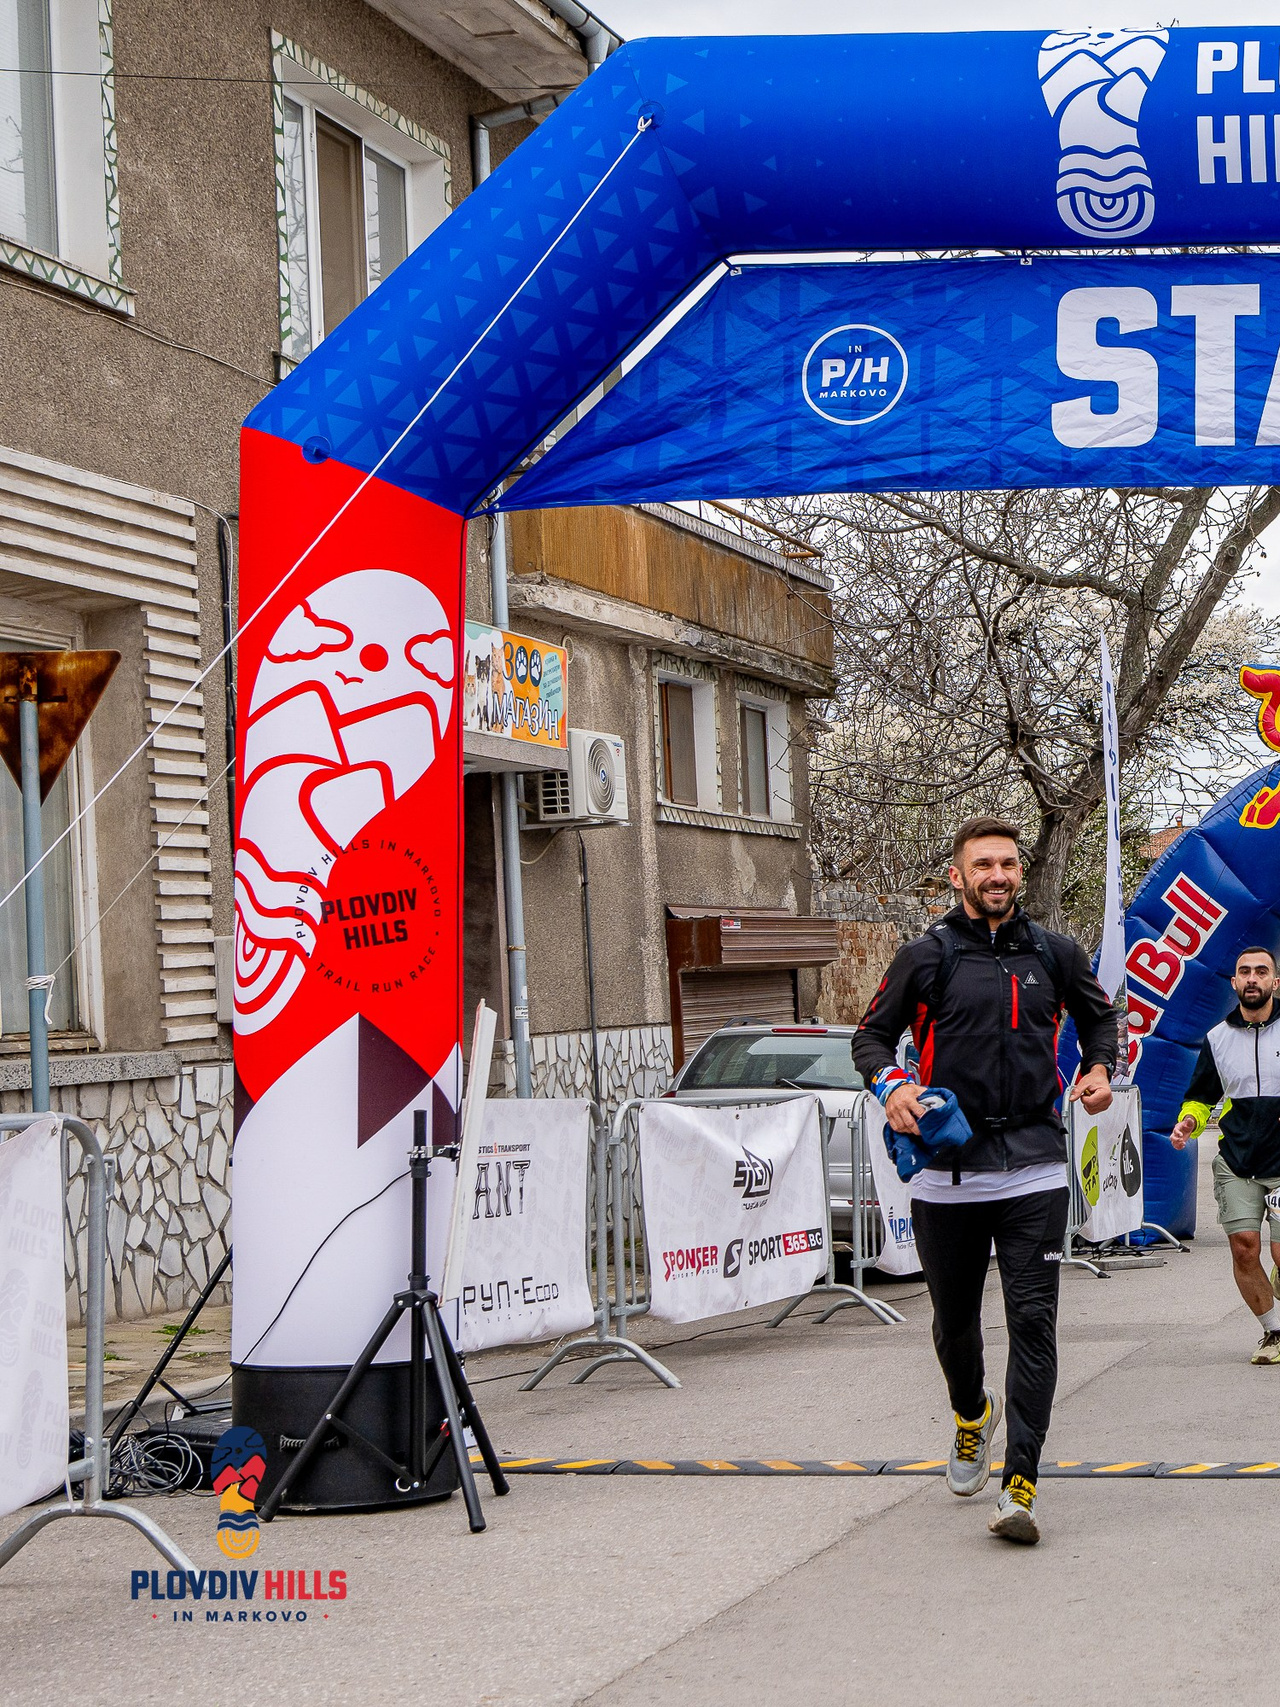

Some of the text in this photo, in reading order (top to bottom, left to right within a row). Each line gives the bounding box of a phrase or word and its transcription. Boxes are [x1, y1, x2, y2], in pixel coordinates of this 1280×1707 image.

[848, 345, 862, 353] IN
[821, 357, 889, 387] P/H
[819, 389, 887, 398] MARKOVO
[492, 691, 560, 740] МАГАЗИН
[294, 839, 441, 939] PLOVDIV HILLS IN MARKOVO
[320, 888, 417, 924] PLOVDIV
[343, 919, 408, 950] HILLS
[1126, 874, 1226, 998] Bull
[316, 947, 436, 993] TRAIL RUN RACE
[498, 1144, 530, 1153] TRANSPORT
[663, 1245, 718, 1282] SPONSER
